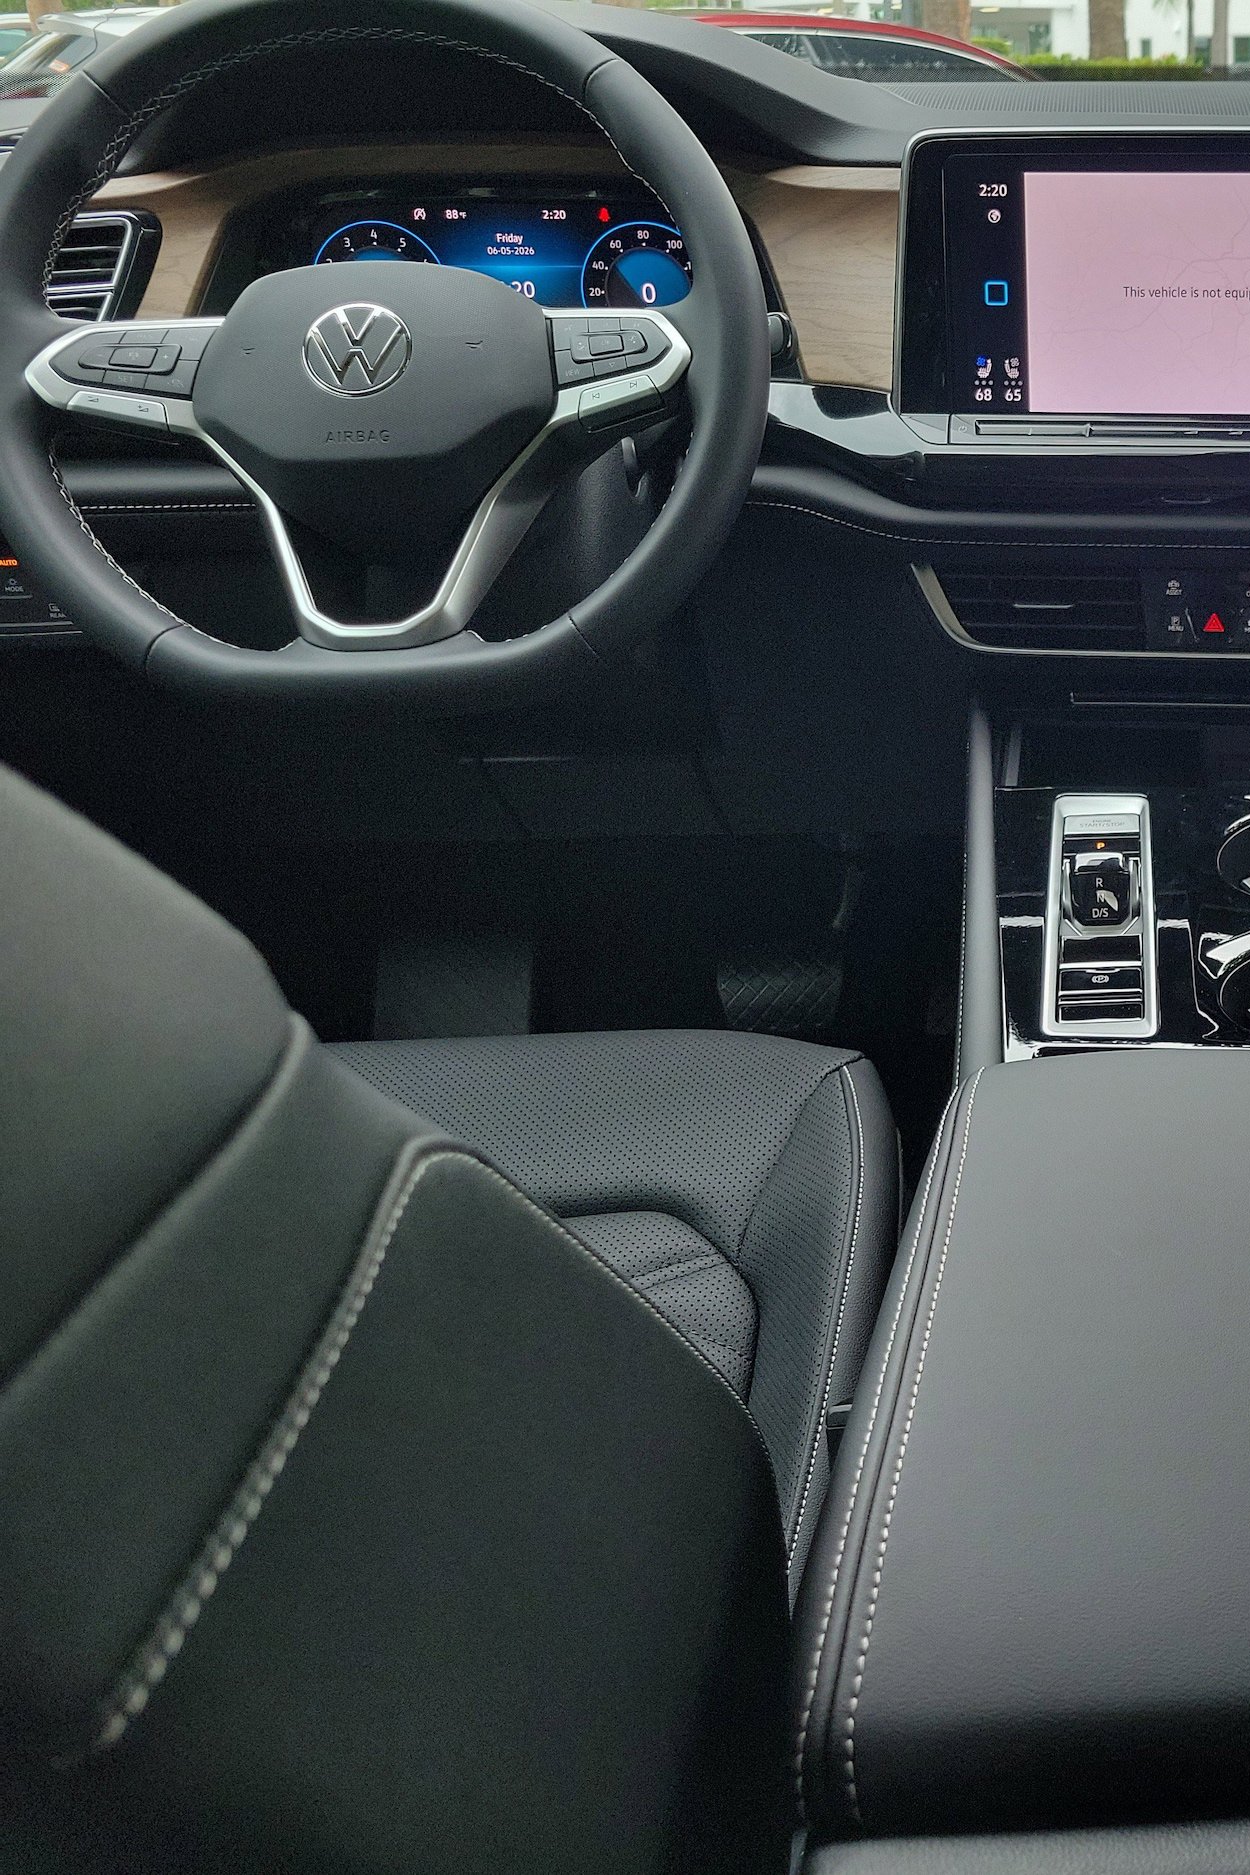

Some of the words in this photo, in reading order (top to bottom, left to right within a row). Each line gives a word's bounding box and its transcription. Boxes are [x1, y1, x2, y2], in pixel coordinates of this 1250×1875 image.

[978, 184, 1008, 197] 2:20
[541, 209, 567, 220] 2:20
[370, 229, 378, 239] 4
[496, 233, 523, 244] Friday
[637, 230, 650, 240] 80
[343, 238, 351, 248] 3
[399, 238, 407, 248] 5
[609, 240, 622, 249] 60
[665, 239, 683, 250] 100
[487, 246, 535, 256] 06-05-2026
[591, 260, 605, 270] 40
[589, 287, 601, 297] 20
[641, 283, 656, 304] 0
[1123, 286, 1146, 298] This
[1148, 286, 1187, 298] vehicle
[1190, 286, 1199, 298] is
[1202, 288, 1221, 299] not
[302, 303, 412, 398] VW
[975, 389, 993, 401] 68
[1004, 389, 1022, 401] 65
[325, 429, 391, 444] AIRBAG
[1096, 877, 1104, 888] R
[1096, 891, 1106, 903] N
[1091, 908, 1109, 918] D/S
